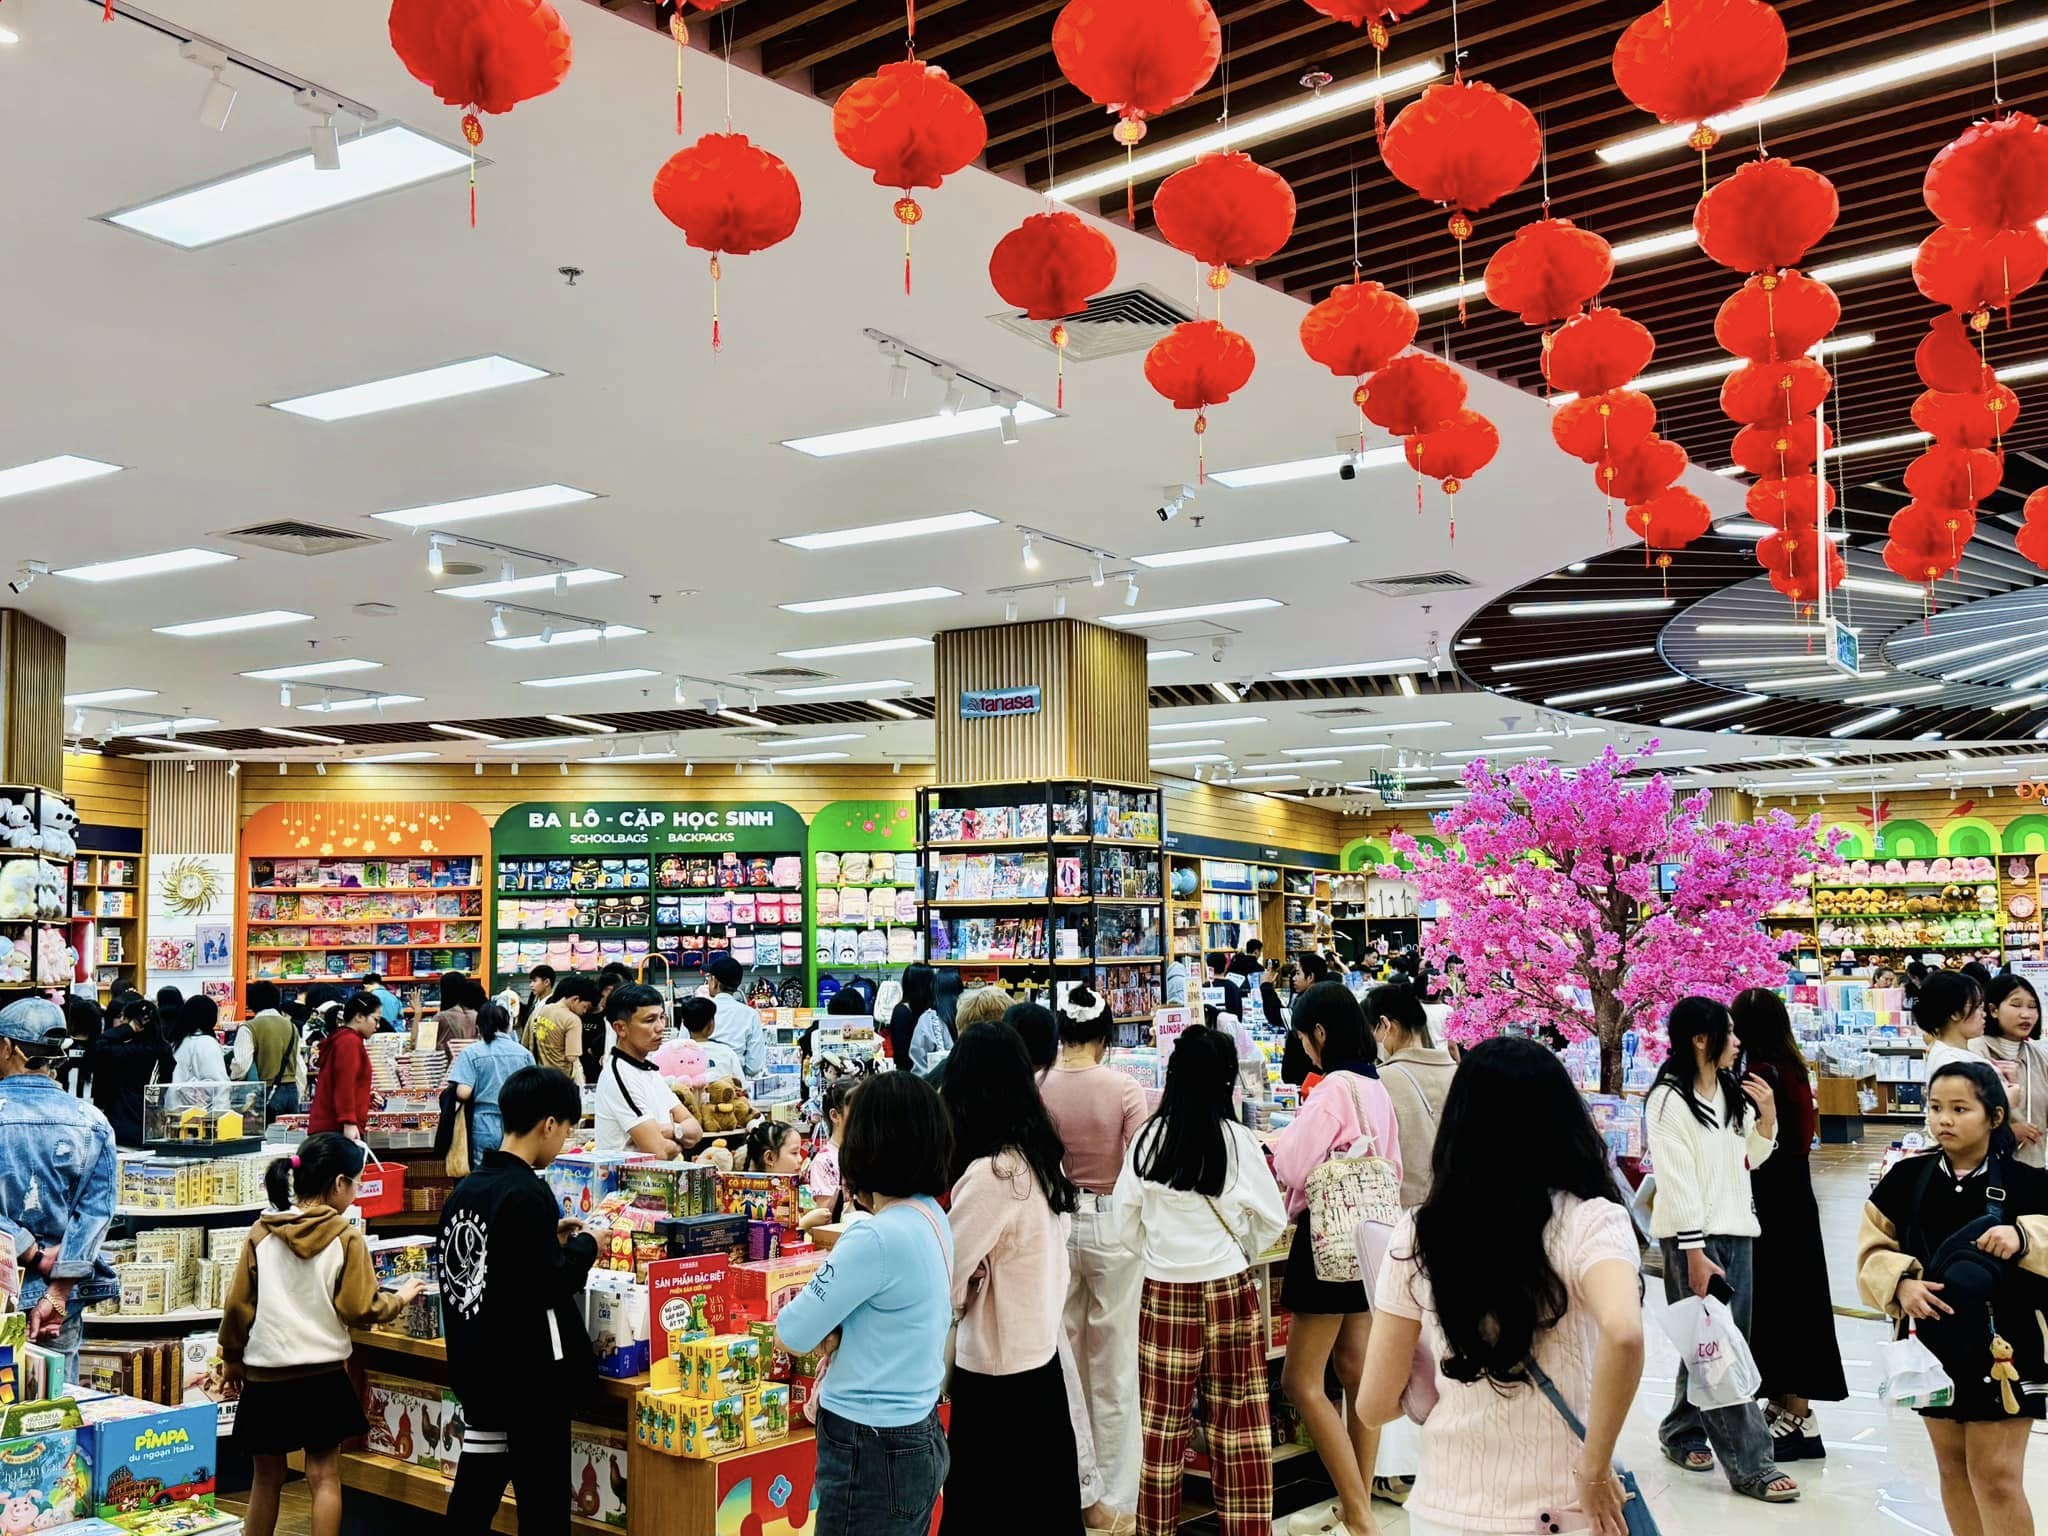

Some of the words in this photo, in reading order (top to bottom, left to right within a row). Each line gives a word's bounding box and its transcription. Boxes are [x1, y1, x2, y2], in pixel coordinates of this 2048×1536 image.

[1371, 26, 1385, 45] 福
[1695, 128, 1713, 145] 福
[899, 203, 915, 221] 福
[1453, 220, 1467, 236] 福
[980, 695, 1034, 712] tanasa
[528, 812, 561, 828] BA
[569, 808, 600, 827] LÔ
[620, 807, 665, 831] CẶP
[673, 811, 719, 831] HỌC
[726, 811, 773, 827] SINH
[570, 832, 648, 844] SCHOOLBAGS
[668, 831, 735, 843] BACKPACKS
[128, 1453, 141, 1463] du
[143, 1449, 171, 1460] ngoạn
[173, 1443, 195, 1454] Italia
